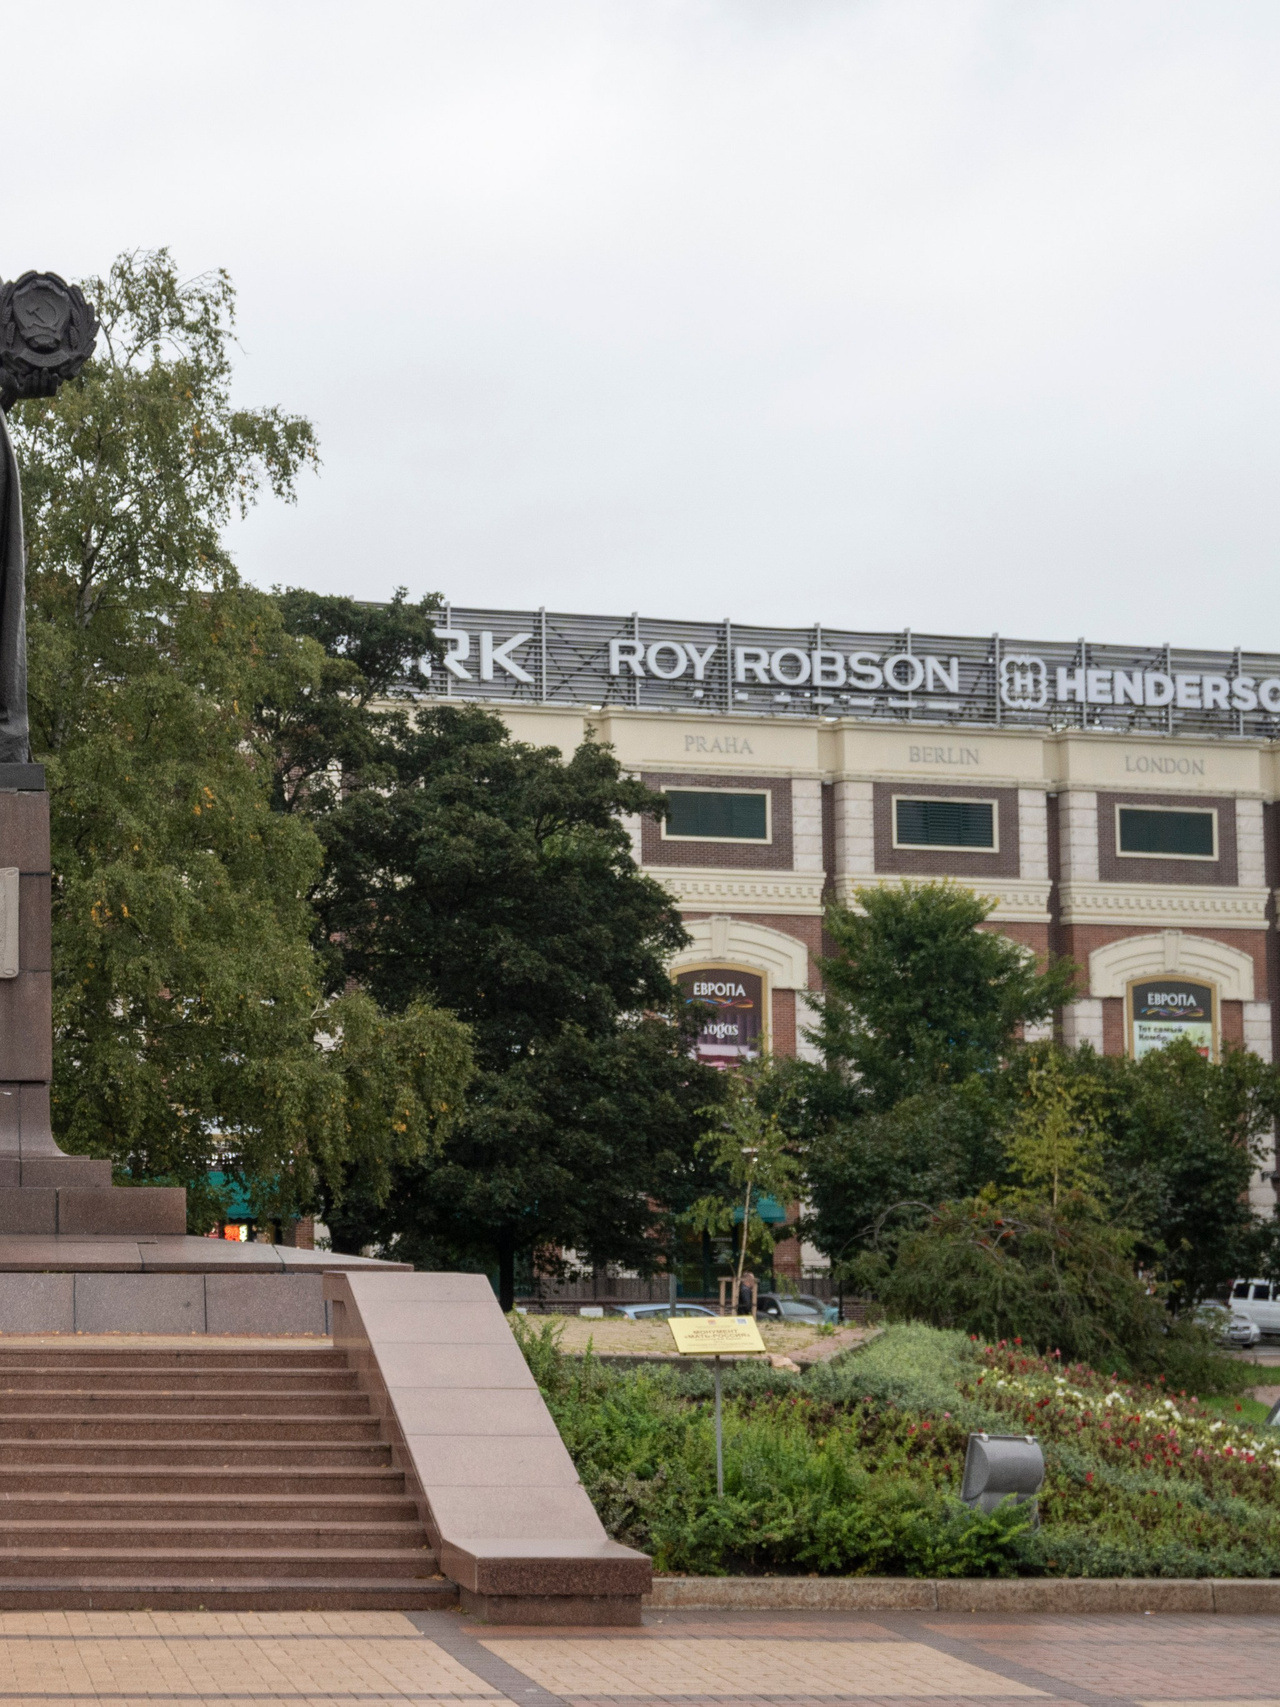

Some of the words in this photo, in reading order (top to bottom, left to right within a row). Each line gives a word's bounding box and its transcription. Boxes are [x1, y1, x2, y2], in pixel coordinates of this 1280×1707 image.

[609, 639, 718, 680] ROY
[735, 647, 960, 693] ROBSON
[684, 734, 754, 755] PRAHA
[909, 745, 980, 765] BERLIN
[1124, 755, 1206, 776] LONDON
[693, 982, 746, 997] ЕВРОПА
[1147, 992, 1197, 1007] ЕВРОПА
